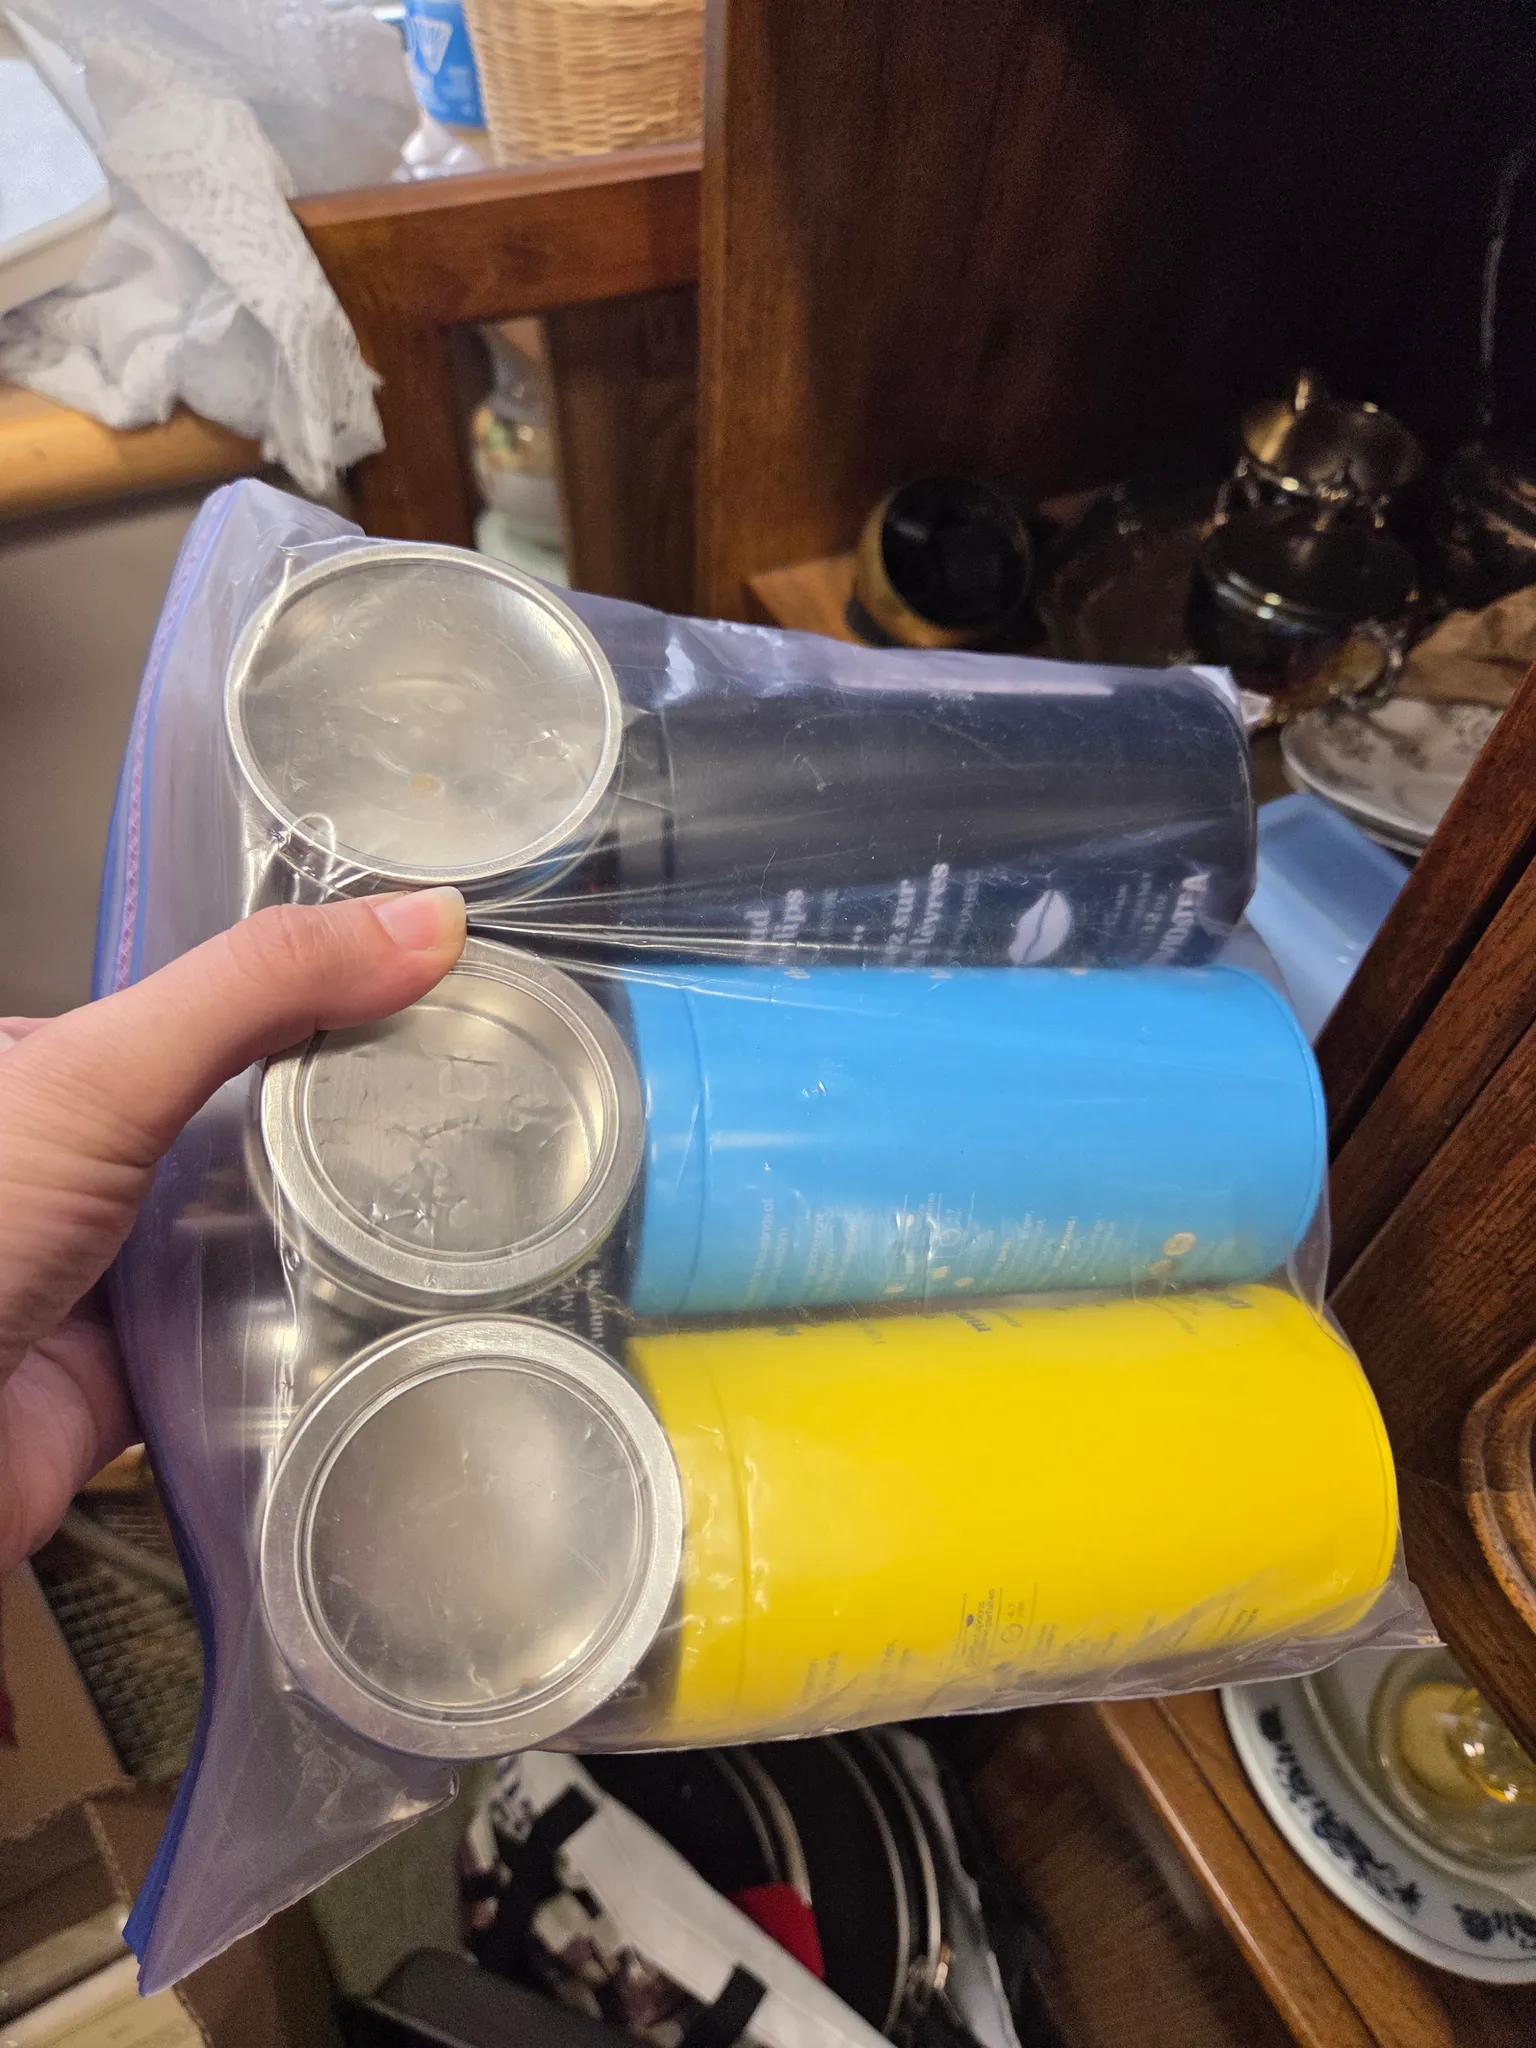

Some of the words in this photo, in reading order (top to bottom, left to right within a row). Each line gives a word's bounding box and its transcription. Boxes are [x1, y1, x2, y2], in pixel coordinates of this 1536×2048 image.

[772, 889, 807, 940] lips
[890, 879, 916, 929] sur
[761, 1197, 774, 1212] of
